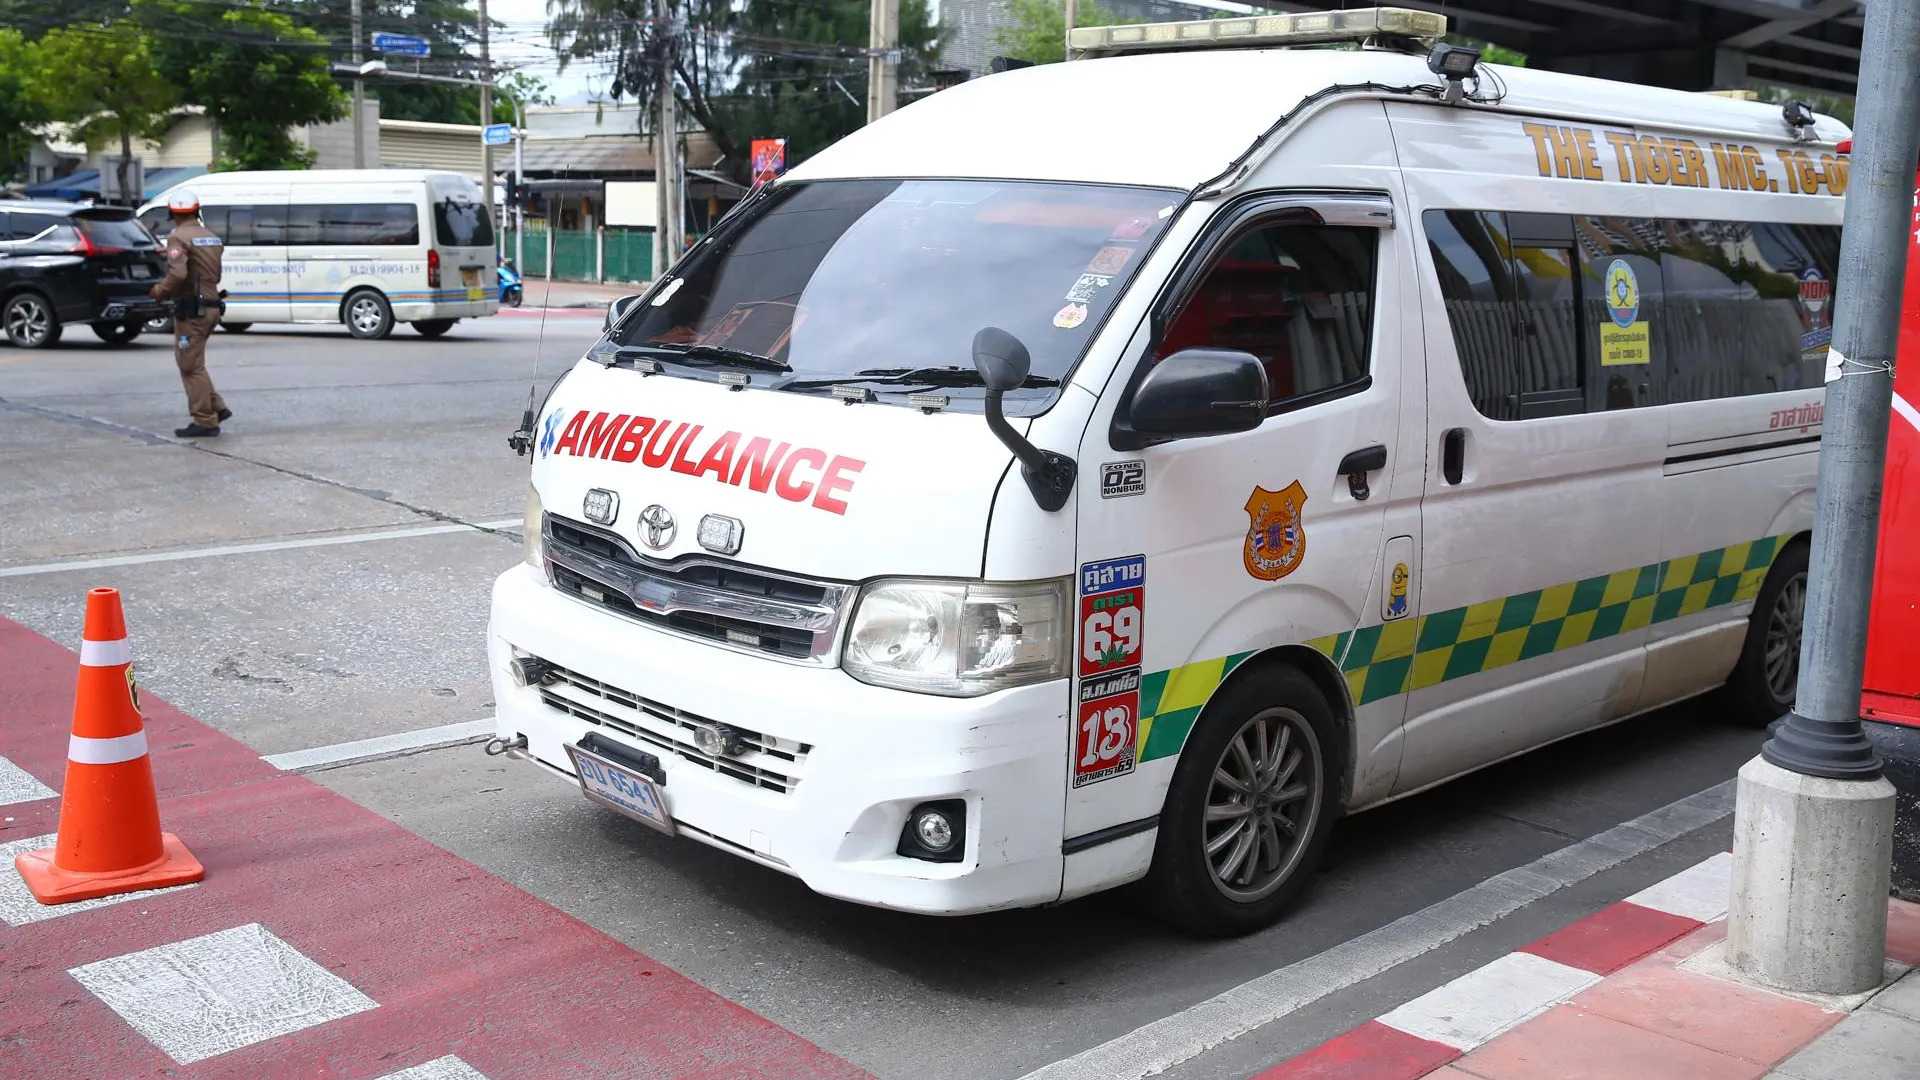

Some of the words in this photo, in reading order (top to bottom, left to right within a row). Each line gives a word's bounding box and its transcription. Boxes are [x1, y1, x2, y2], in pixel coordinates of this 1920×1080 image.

[1522, 121, 1603, 181] THE
[1603, 130, 1709, 188] TIGER
[1709, 142, 1778, 193] MC.
[554, 410, 866, 515] AMBULANCE
[1104, 462, 1141, 472] ZONE
[1104, 468, 1143, 487] 02
[1103, 483, 1144, 495] NONBURI
[1084, 563, 1143, 592] คู่สาย
[1084, 606, 1140, 663] 69
[1081, 704, 1132, 767] 13
[607, 766, 657, 808] 6541
